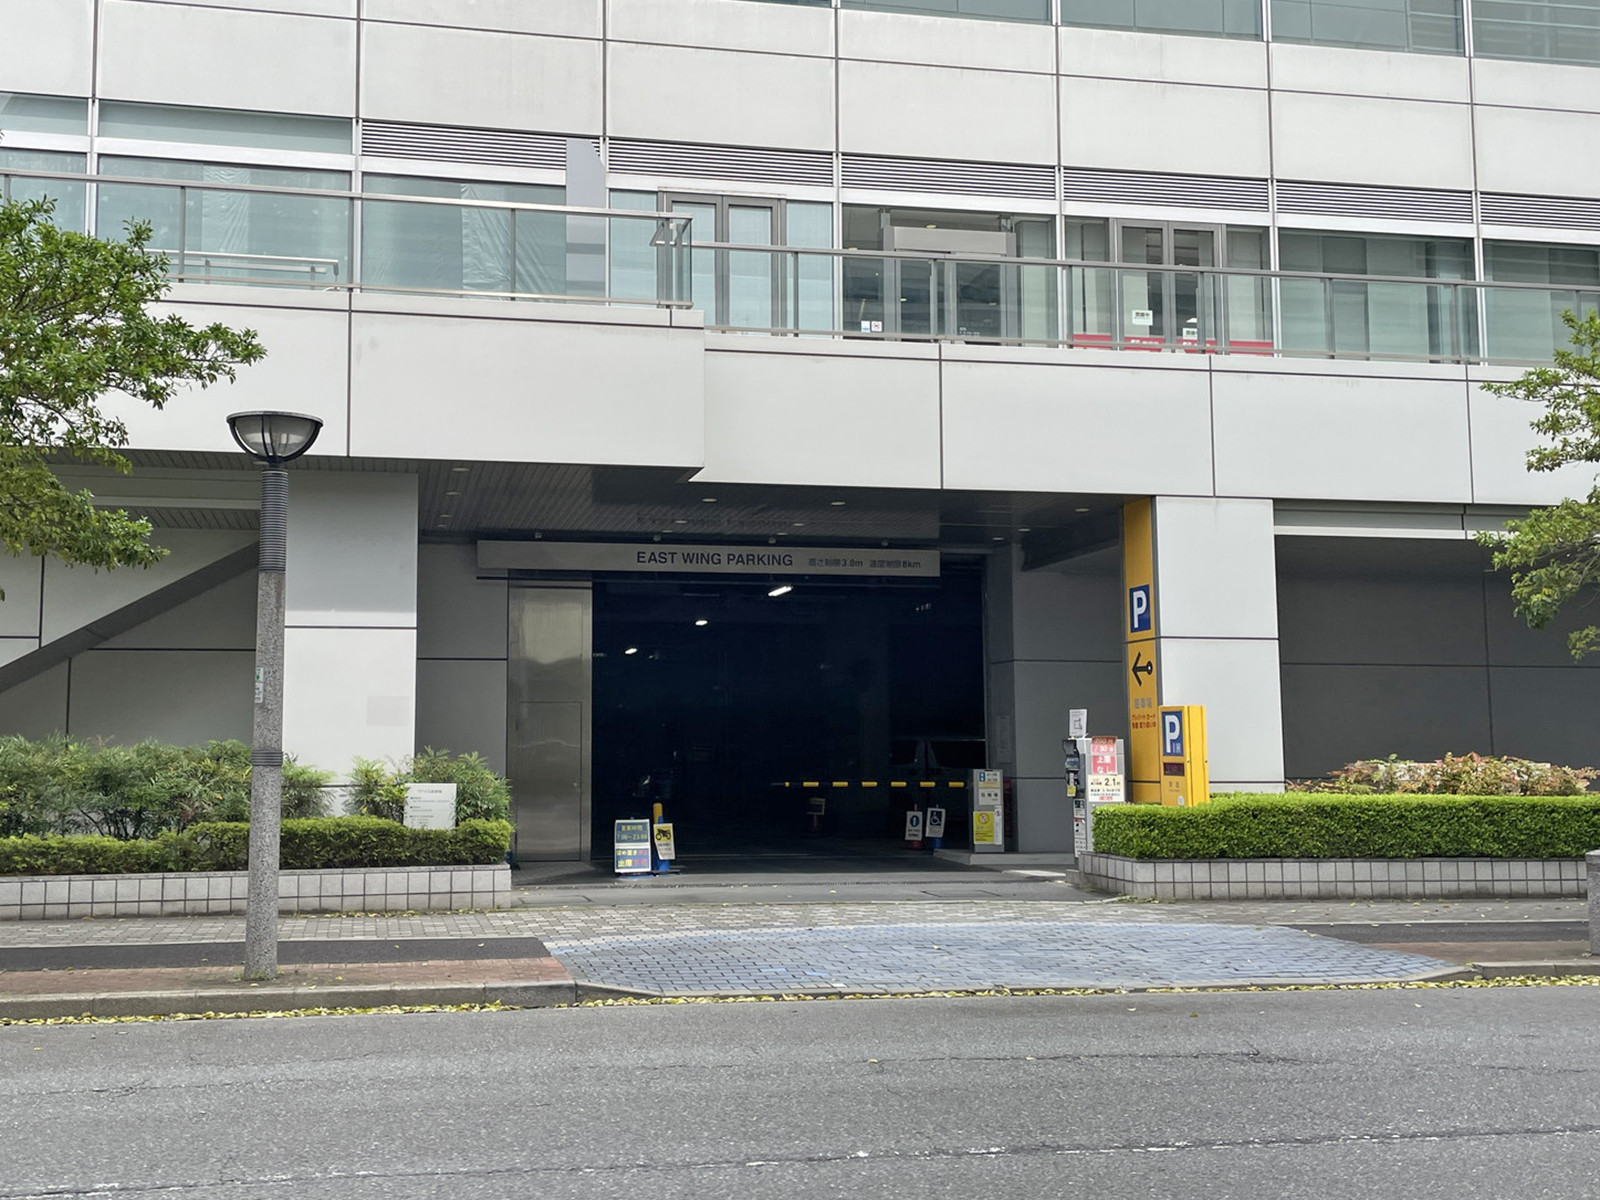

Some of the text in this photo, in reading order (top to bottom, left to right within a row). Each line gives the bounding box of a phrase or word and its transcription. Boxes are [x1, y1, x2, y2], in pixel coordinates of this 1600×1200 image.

[636, 551, 793, 566] EAST WING PARKING
[1133, 589, 1147, 629] P
[1165, 714, 1180, 754] P
